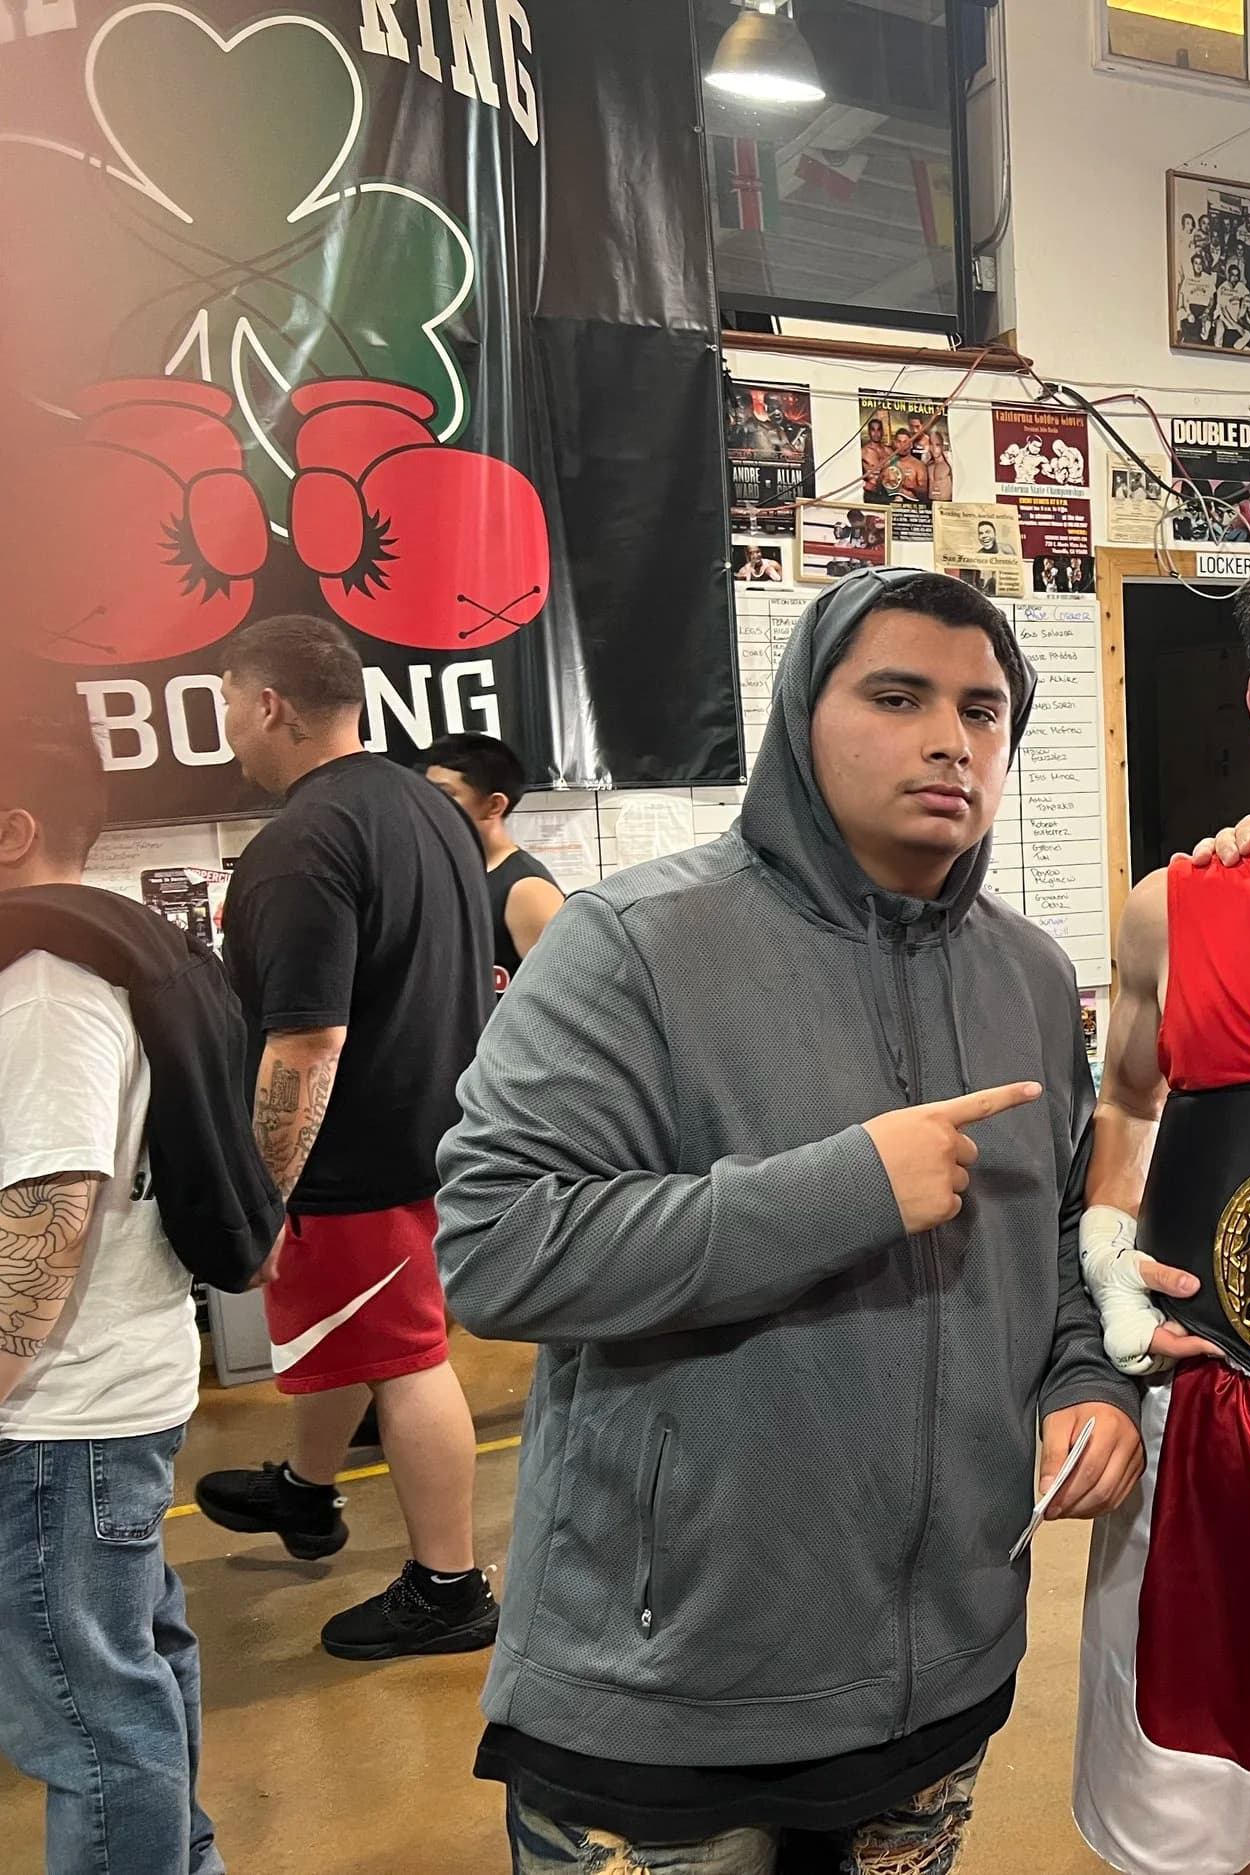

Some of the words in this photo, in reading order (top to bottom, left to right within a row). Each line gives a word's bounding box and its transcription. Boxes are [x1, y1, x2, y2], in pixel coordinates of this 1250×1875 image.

[908, 403, 934, 415] BEACH
[1173, 419, 1239, 447] DOUBLE
[733, 466, 760, 483] ANDRE
[777, 468, 802, 485] ALLAN
[735, 483, 760, 498] WARD
[942, 553, 955, 562] San
[76, 659, 501, 773] BONG
[193, 868, 231, 883] PPERCU
